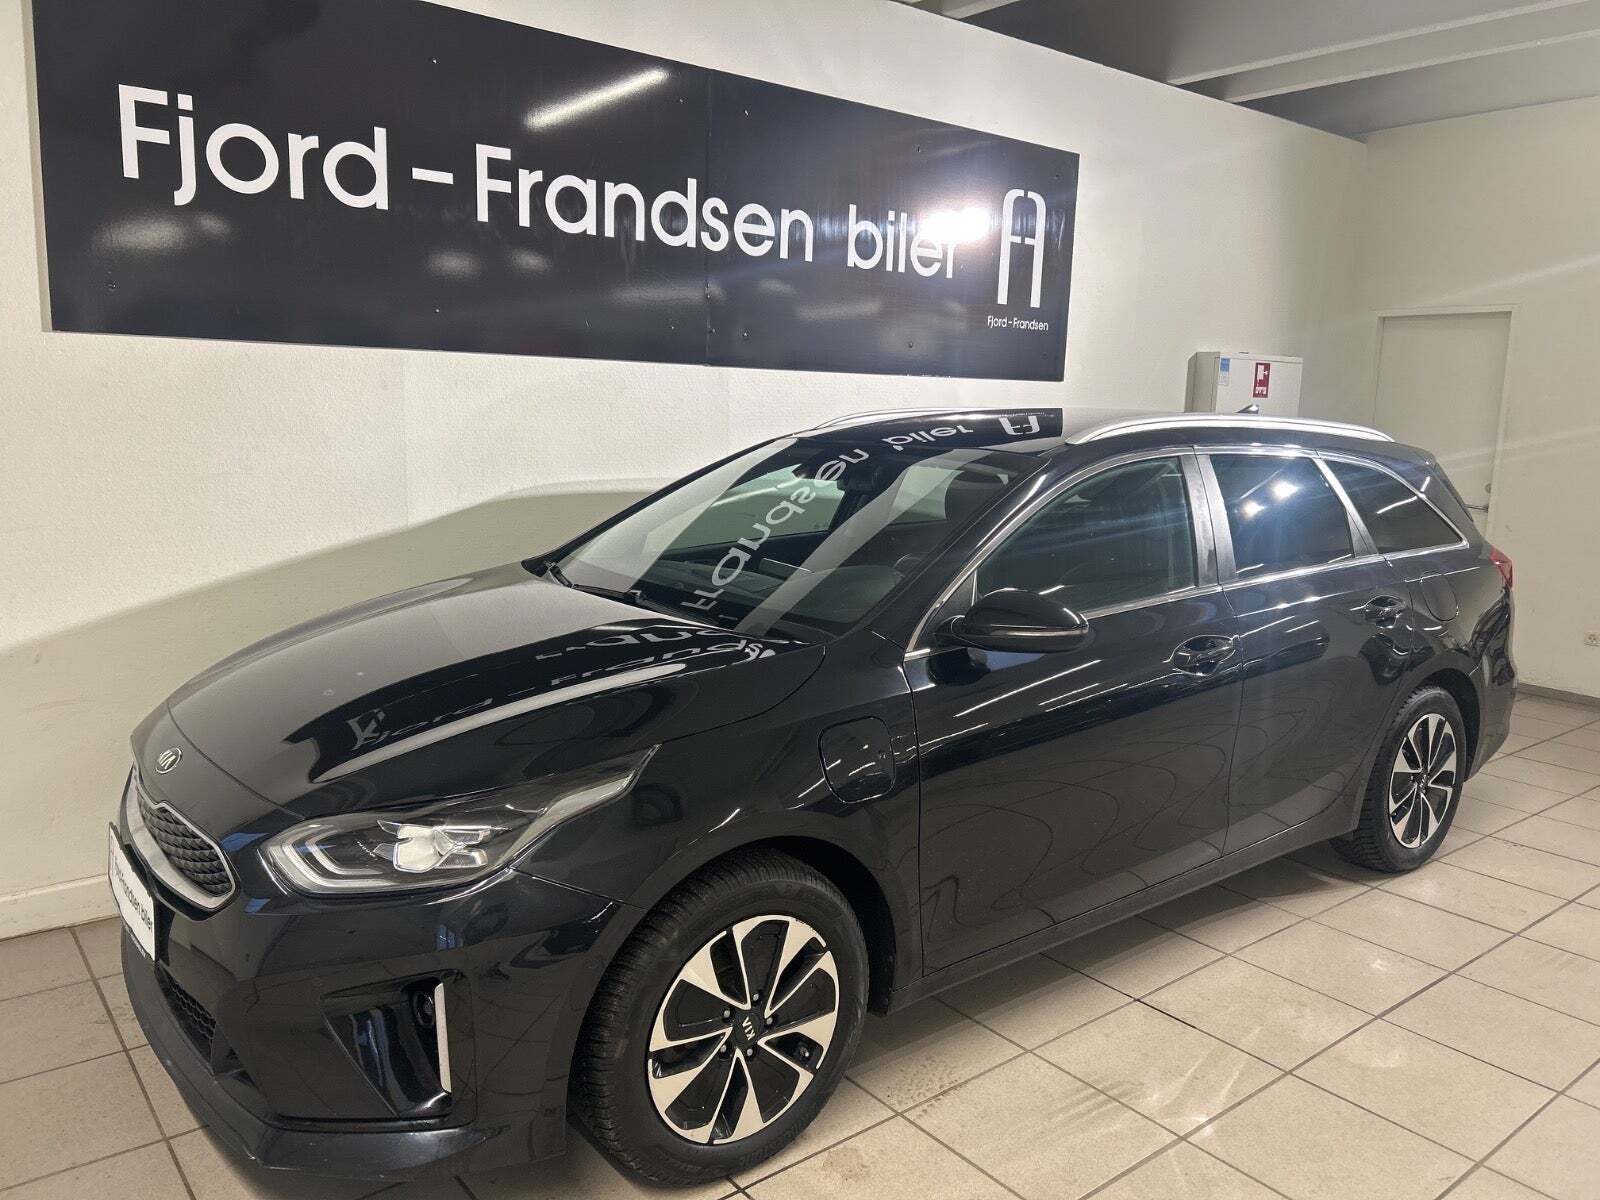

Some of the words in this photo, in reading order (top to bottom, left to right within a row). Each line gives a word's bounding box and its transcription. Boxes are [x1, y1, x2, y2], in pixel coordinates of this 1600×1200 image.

[118, 84, 389, 210] Fjord
[475, 143, 814, 262] Frandsen
[847, 203, 958, 279] biler
